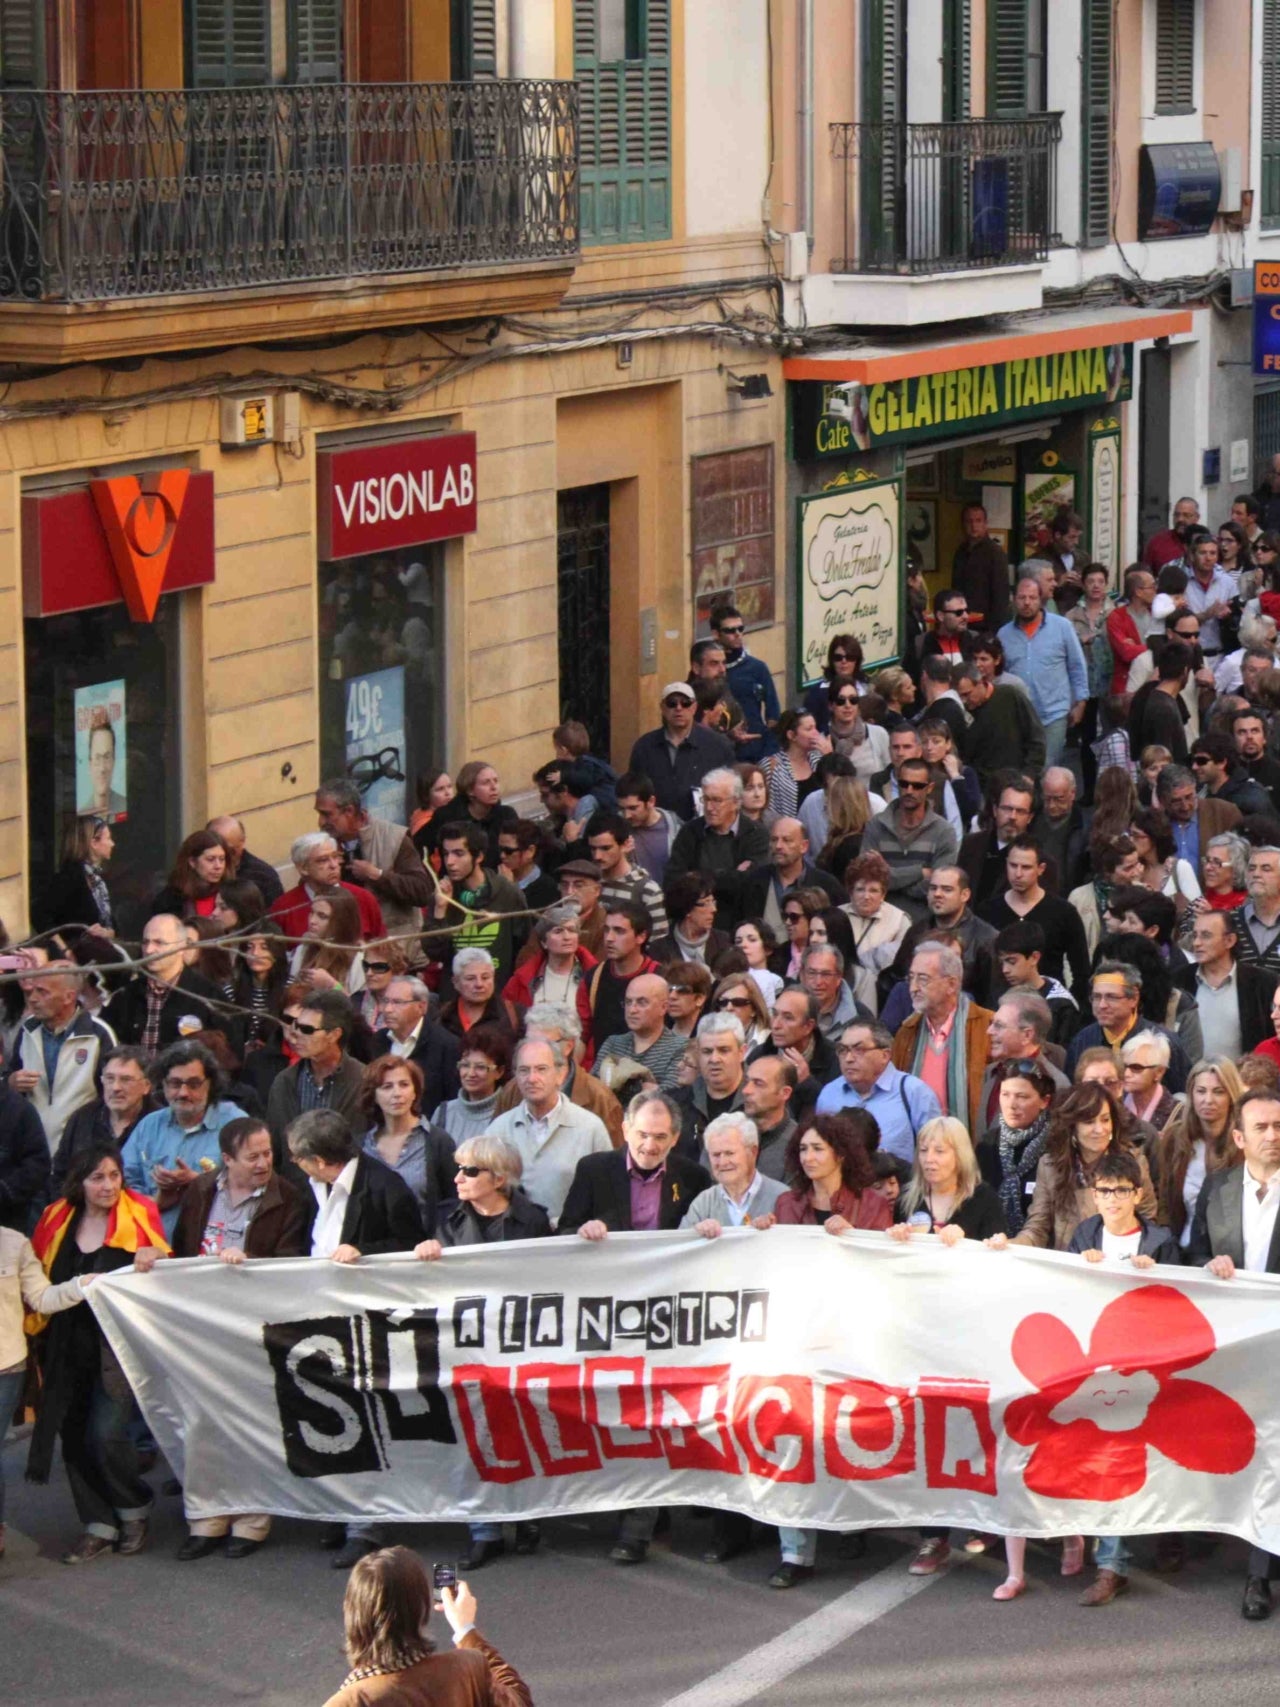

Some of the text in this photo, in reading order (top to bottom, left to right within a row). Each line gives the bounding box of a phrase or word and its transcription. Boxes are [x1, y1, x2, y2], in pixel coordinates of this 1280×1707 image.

[868, 366, 998, 436] GELATERIA
[1004, 346, 1108, 409] ITALIANA
[335, 463, 474, 528] VISIONLAB
[834, 523, 868, 543] Gelateria
[345, 680, 383, 740] 49€
[456, 1292, 767, 1351] A LA NOSTRA
[457, 1363, 992, 1486] LLENGUA
